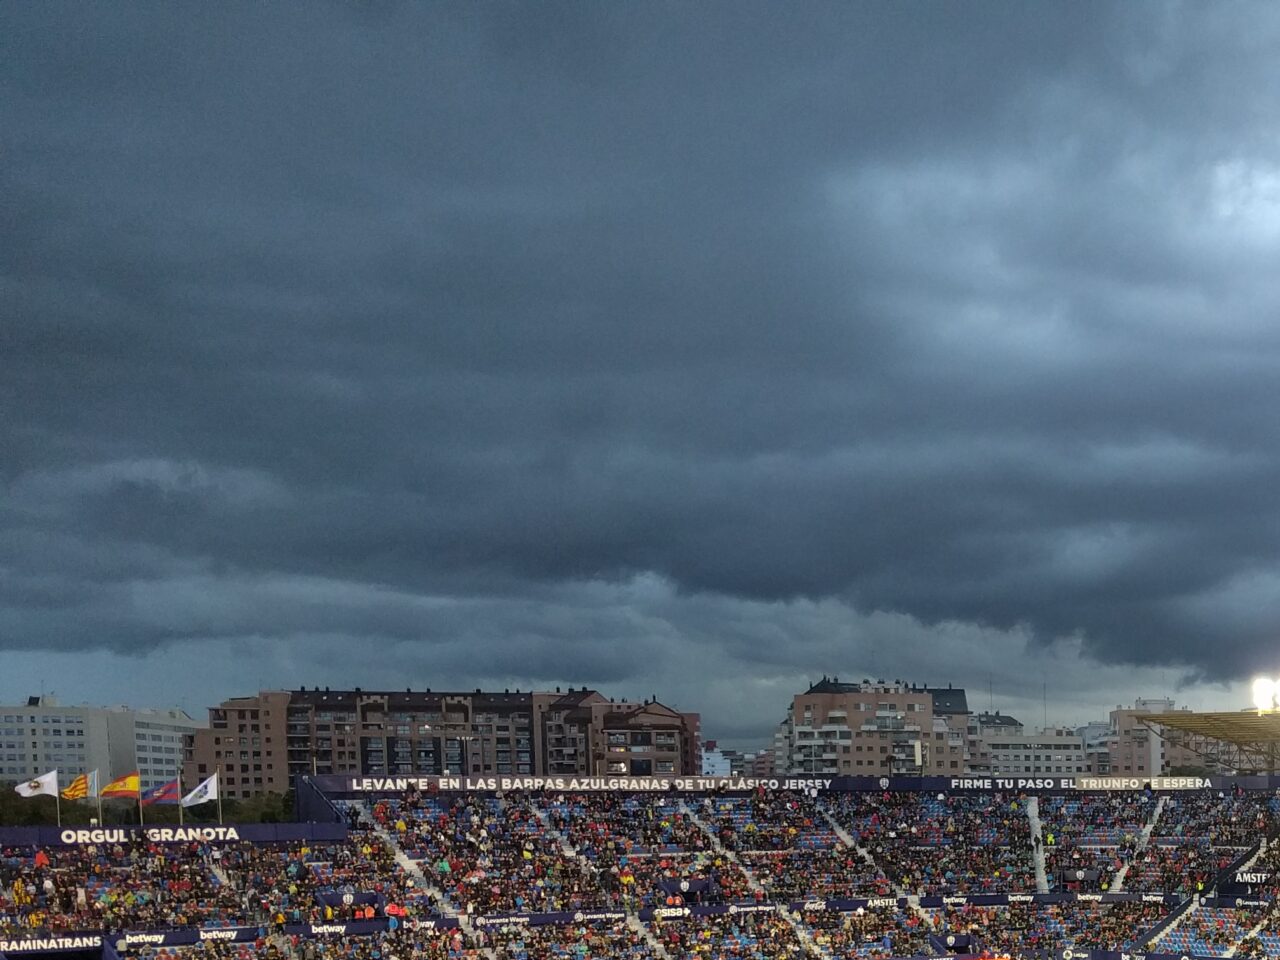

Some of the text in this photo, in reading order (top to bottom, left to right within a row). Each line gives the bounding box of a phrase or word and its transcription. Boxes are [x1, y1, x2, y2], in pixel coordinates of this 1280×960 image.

[439, 778, 460, 790] EN
[466, 778, 497, 790] LAS
[502, 778, 564, 790] BARRAS
[570, 778, 669, 790] AZULGRANAS
[675, 779, 693, 790] DE
[697, 779, 715, 790] TU
[719, 777, 778, 790] CLÁSICO
[782, 779, 832, 790] JERSEY
[951, 778, 1212, 789] FIRME TU PASO EL TRIUNFO TE ESPERA
[148, 827, 240, 842] GRANOTA
[1236, 873, 1271, 884] AMSTE
[867, 898, 898, 907] AMSTEL
[943, 896, 967, 905] betway
[1008, 894, 1034, 902] betway
[1077, 894, 1103, 902] betway
[1142, 894, 1164, 903] betway
[312, 924, 346, 935] betway
[403, 920, 435, 930] beway
[126, 934, 165, 944] betway
[200, 929, 237, 940] betway
[1, 936, 102, 952] RAMINATRANS
